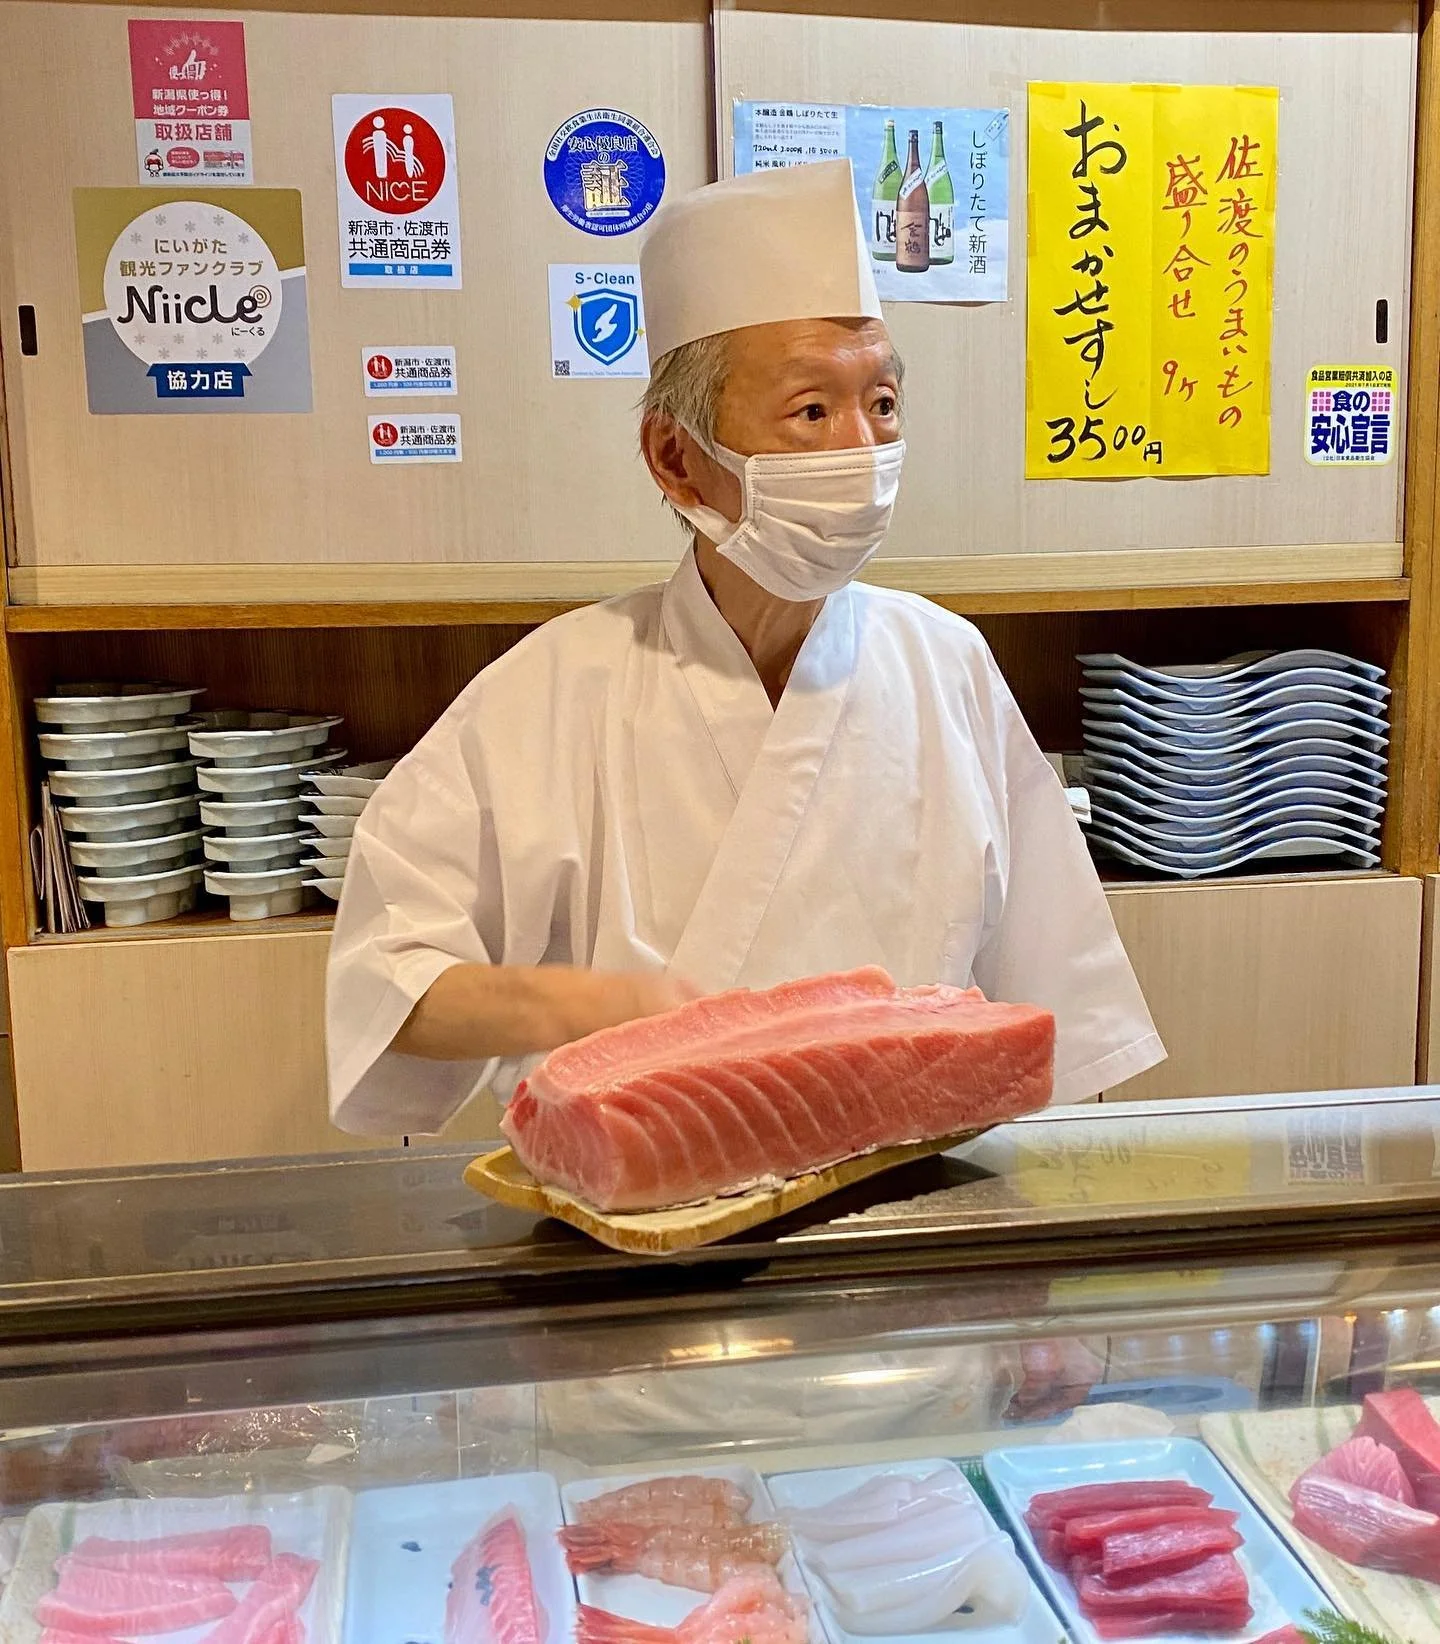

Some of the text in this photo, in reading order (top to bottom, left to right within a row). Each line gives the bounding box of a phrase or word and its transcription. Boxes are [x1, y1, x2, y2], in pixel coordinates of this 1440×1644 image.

[153, 104, 229, 117] 地域クーポン券
[155, 123, 232, 141] 取扱店舗
[568, 135, 638, 152] 安心優良店
[366, 180, 429, 202] NICE
[581, 160, 631, 211] 証
[968, 130, 988, 274] しぼりたて新酒
[348, 220, 449, 237] 新潟市・佐渡市
[155, 238, 228, 254] にいがた
[348, 238, 451, 260] 共通商品券
[119, 260, 264, 277] 観光ファンクラブ
[575, 271, 635, 285] S-Clean
[1215, 134, 1264, 429] 佐渡のうまいもの
[117, 284, 266, 324] Niicle
[231, 327, 266, 337] にーくる
[167, 370, 234, 391] 協力店
[395, 367, 452, 379] 共通商品券
[1332, 390, 1371, 413] 食の
[400, 434, 457, 446] 共通商品券
[1311, 413, 1391, 455] 安心宣言
